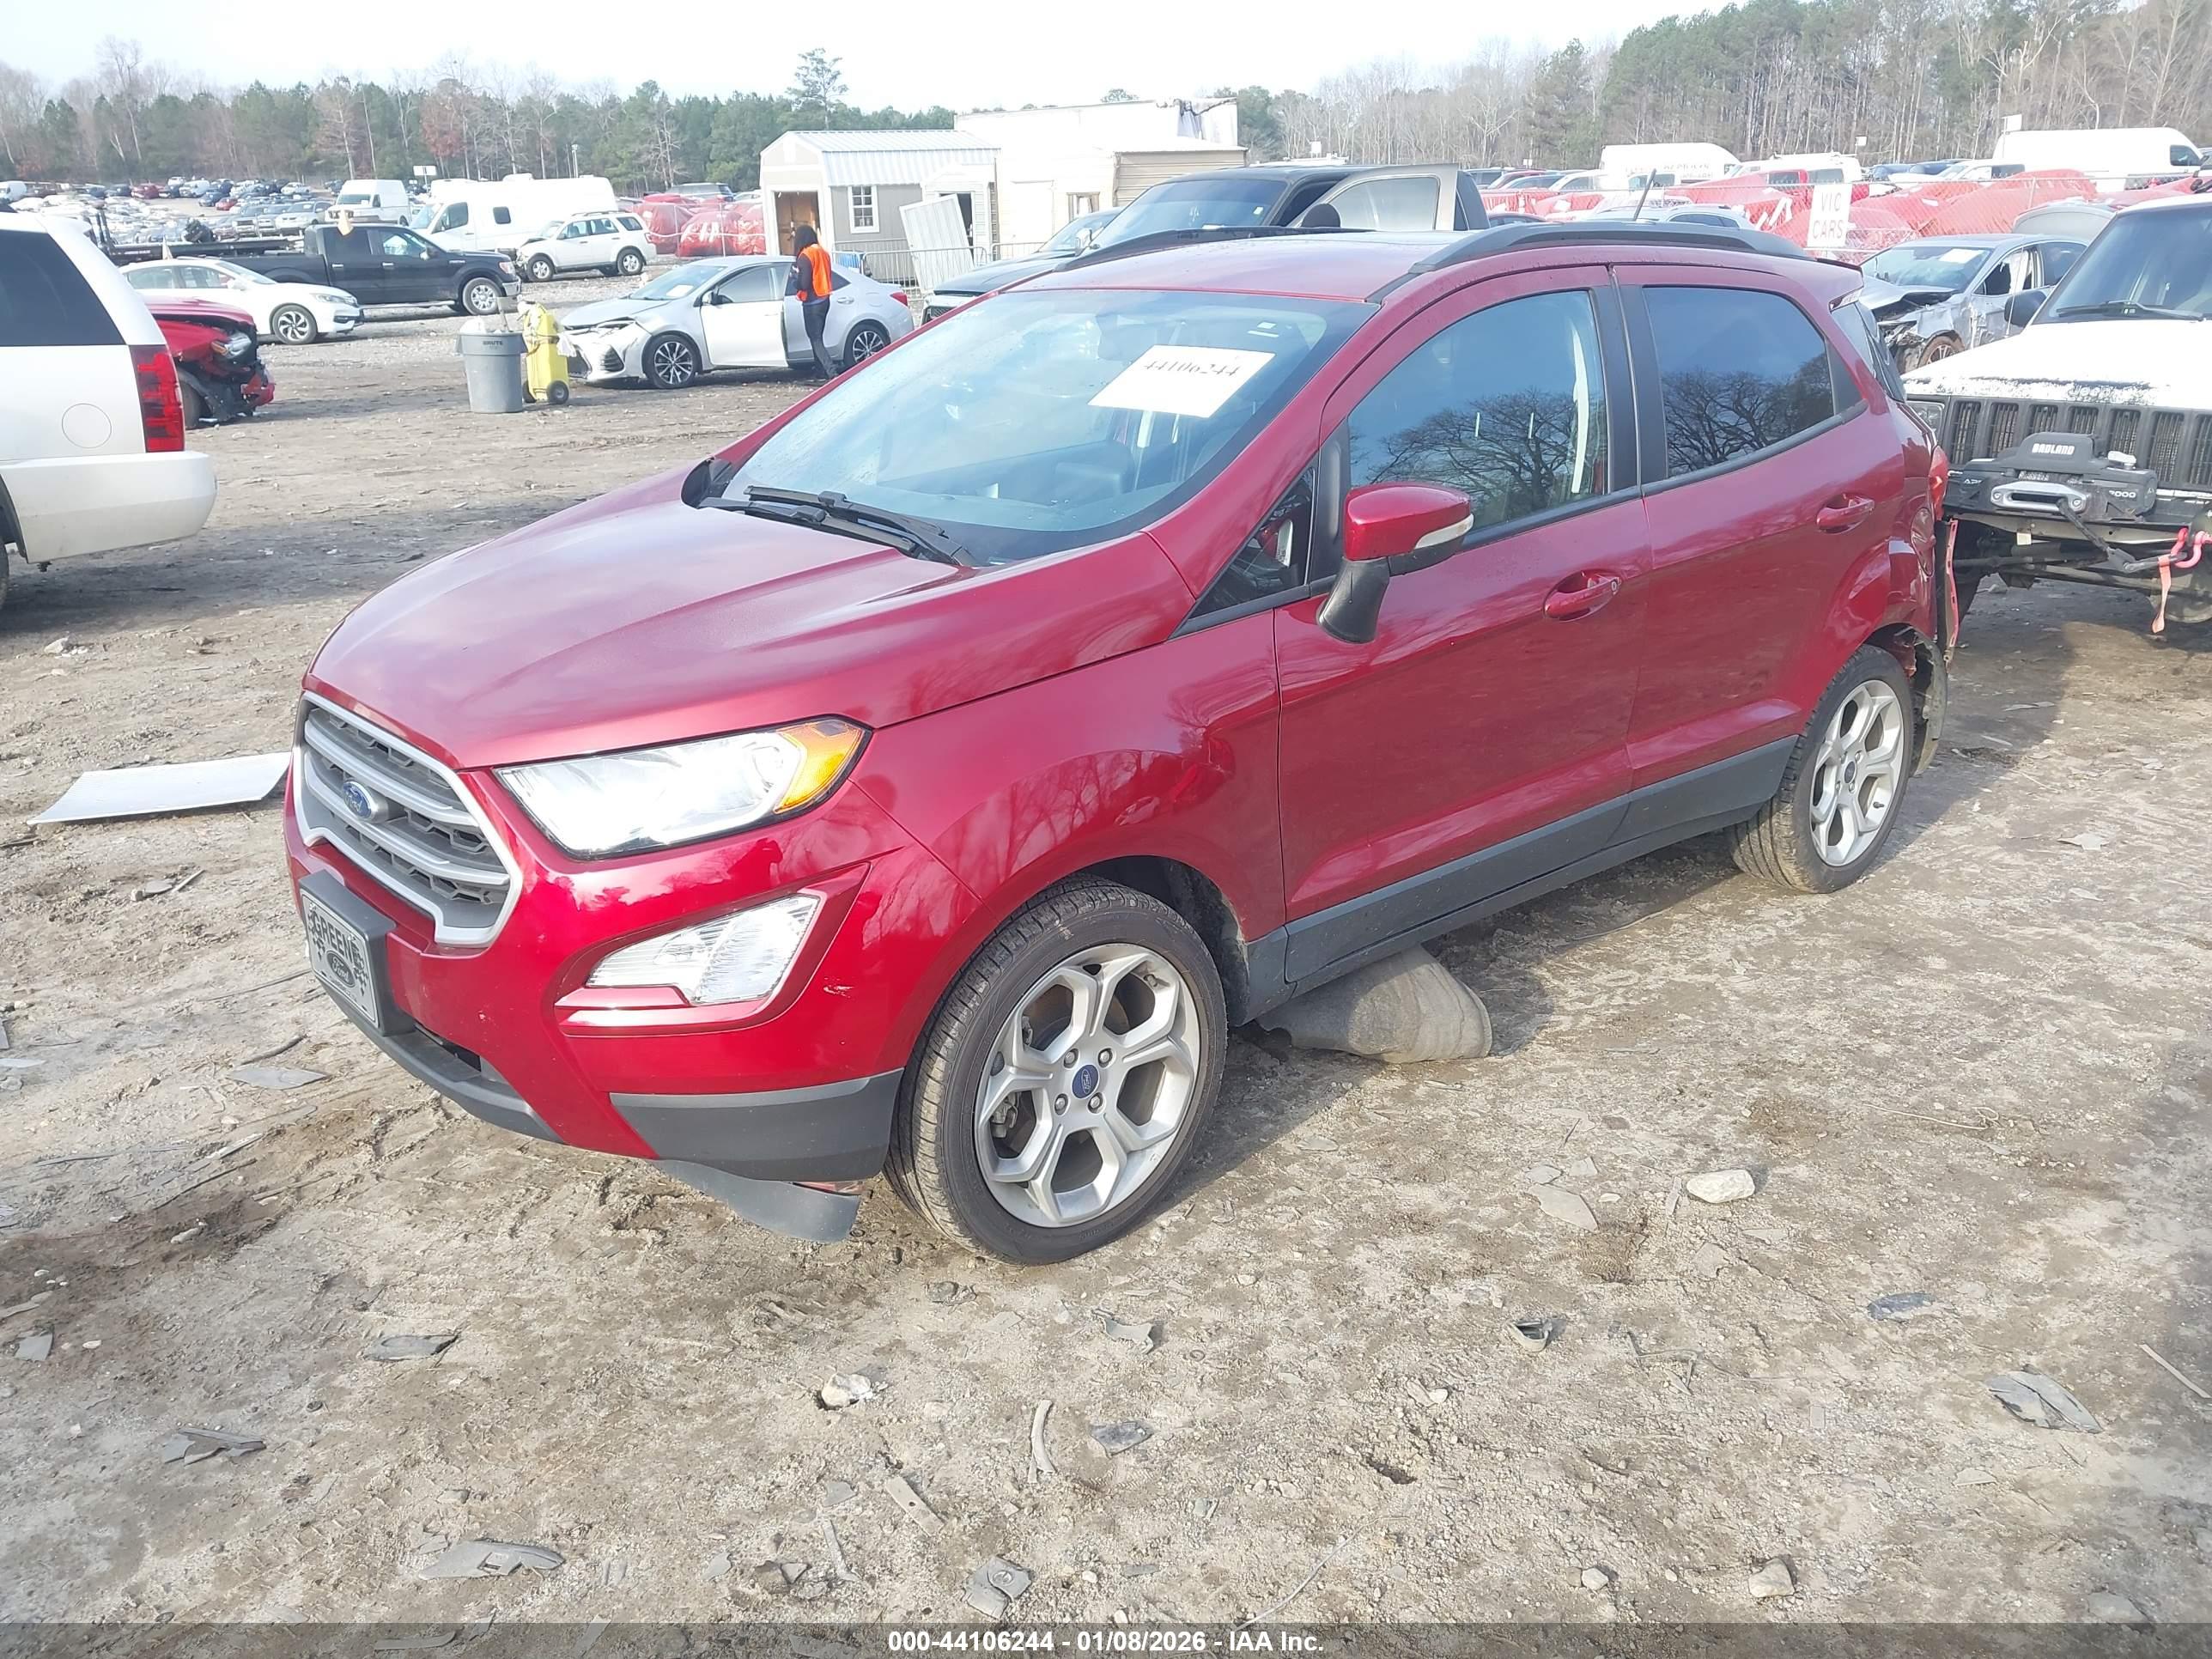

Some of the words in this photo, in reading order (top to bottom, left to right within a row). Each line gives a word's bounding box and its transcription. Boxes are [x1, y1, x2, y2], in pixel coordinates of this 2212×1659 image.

[1813, 219, 1844, 240] CARS
[2032, 442, 2075, 456] BADLAND
[343, 785, 366, 815] Ford
[330, 955, 351, 984] Ford
